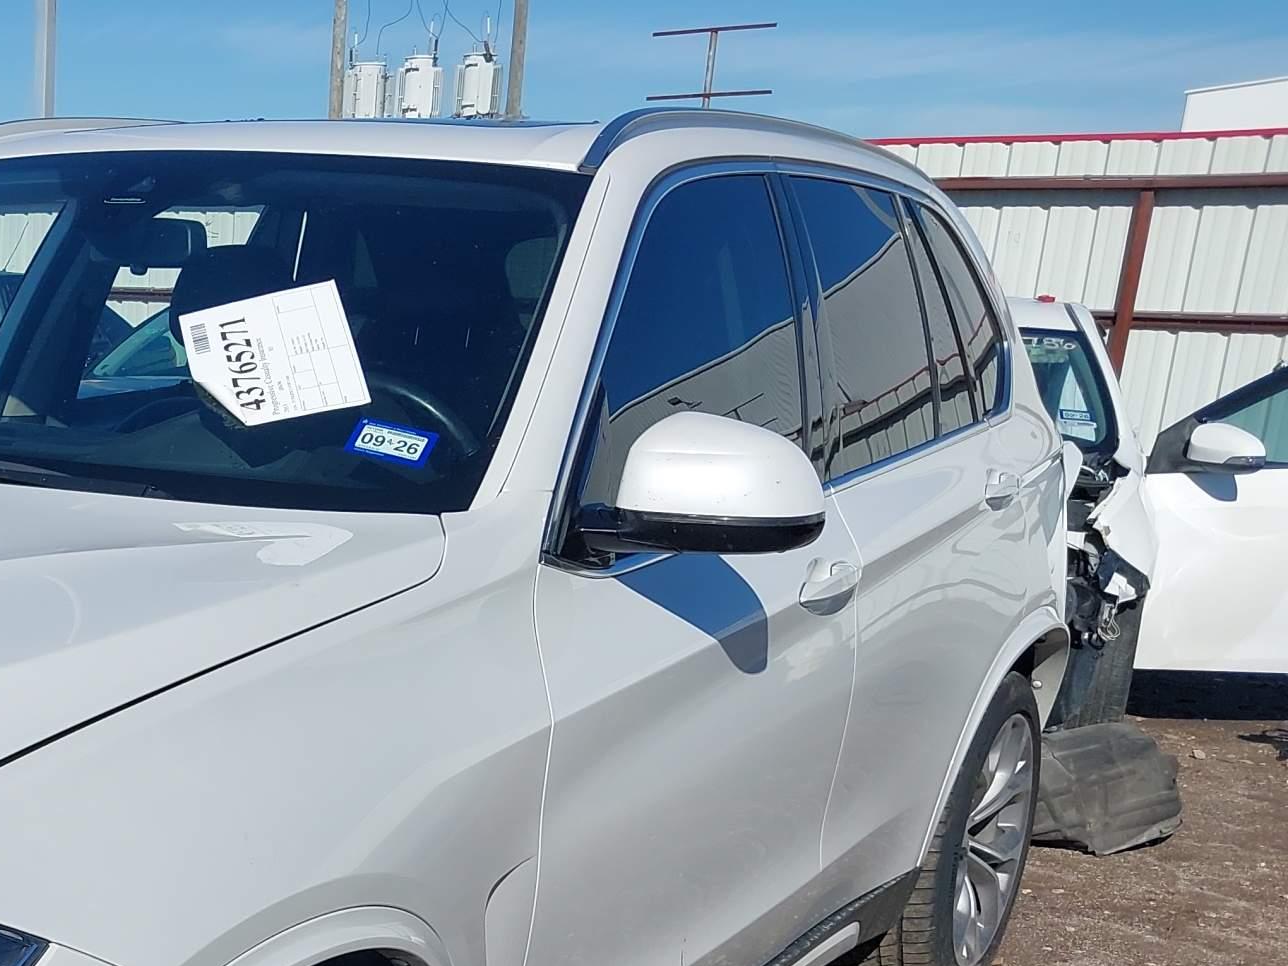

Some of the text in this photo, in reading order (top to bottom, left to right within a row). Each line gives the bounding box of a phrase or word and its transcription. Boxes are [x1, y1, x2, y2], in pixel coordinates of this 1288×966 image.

[219, 317, 267, 412] 43765271
[361, 432, 386, 447] 09
[393, 438, 420, 455] 26
